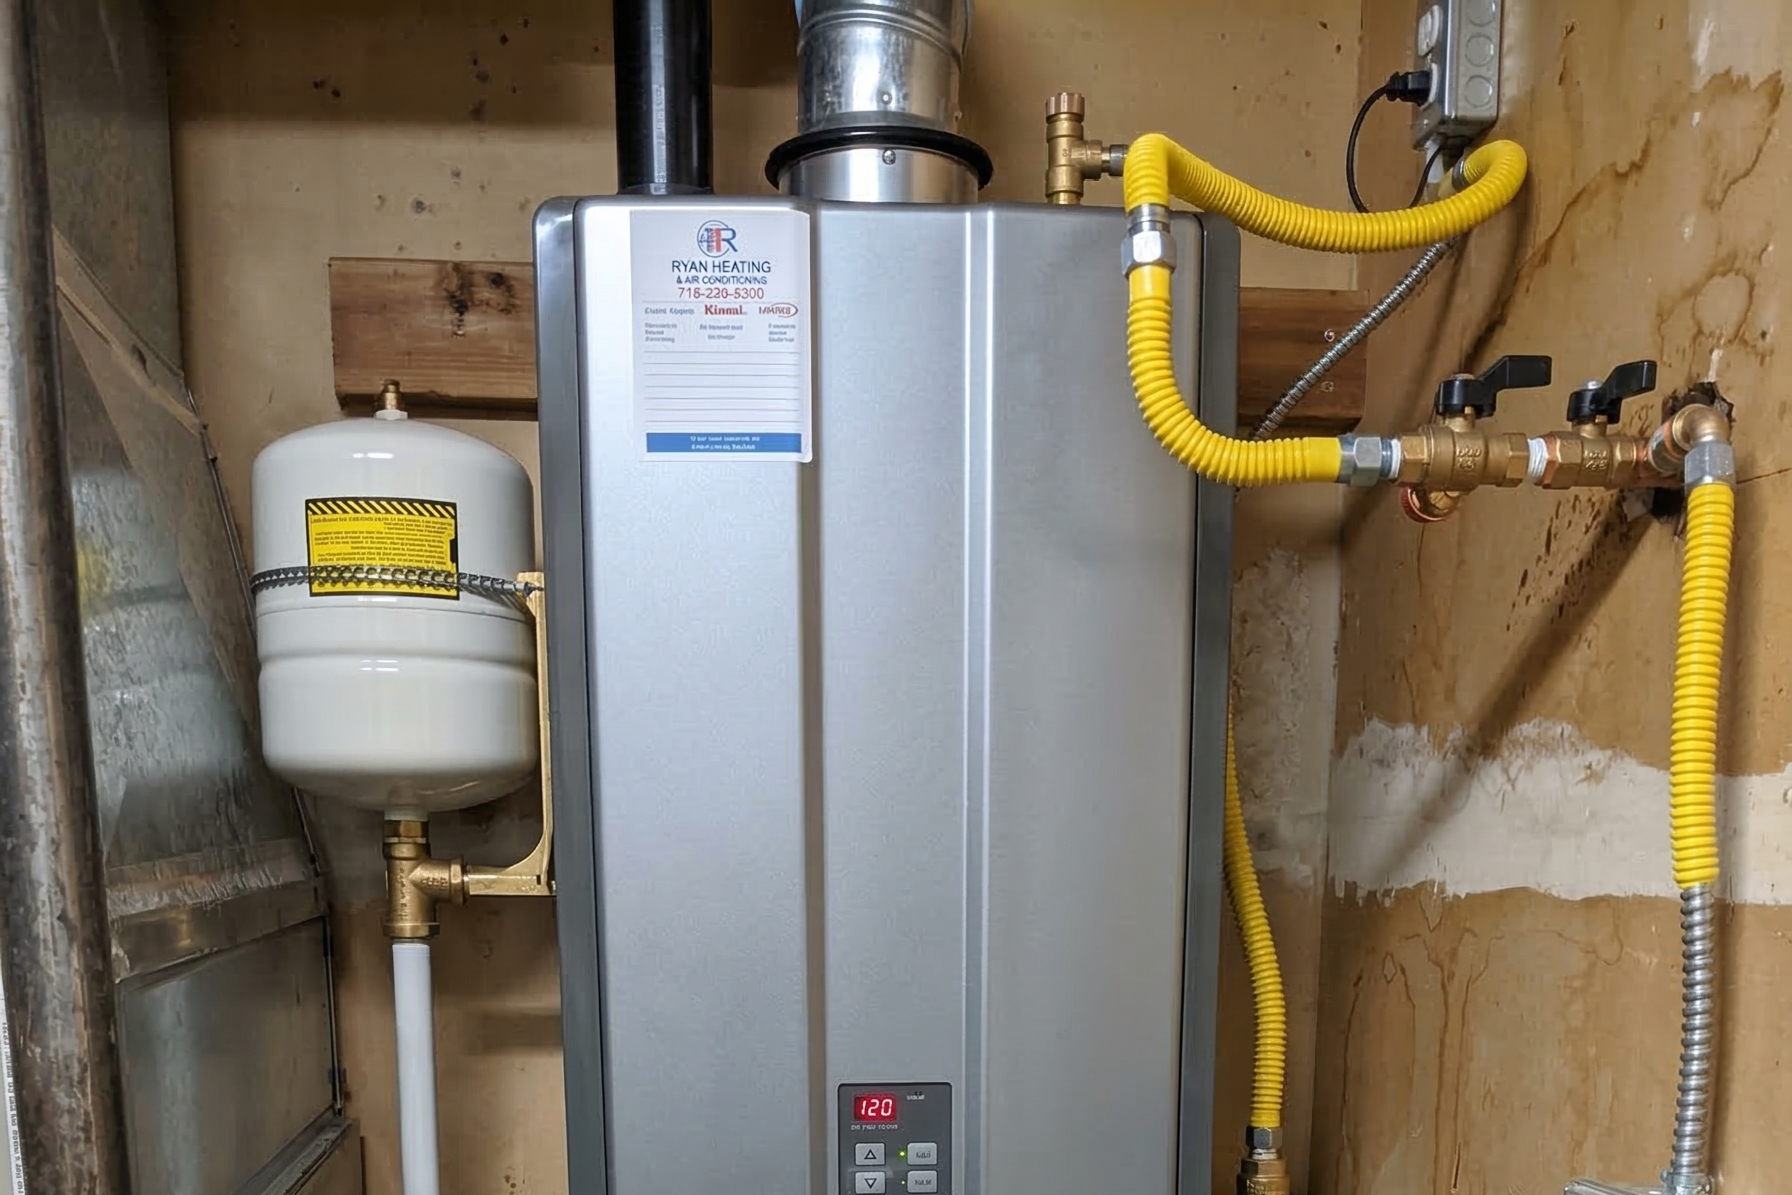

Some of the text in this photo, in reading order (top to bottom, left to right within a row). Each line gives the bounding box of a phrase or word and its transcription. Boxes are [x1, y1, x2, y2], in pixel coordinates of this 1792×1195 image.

[671, 260, 772, 273] RYAN HEATING
[684, 275, 700, 284] AIR
[861, 1098, 893, 1117] 120
